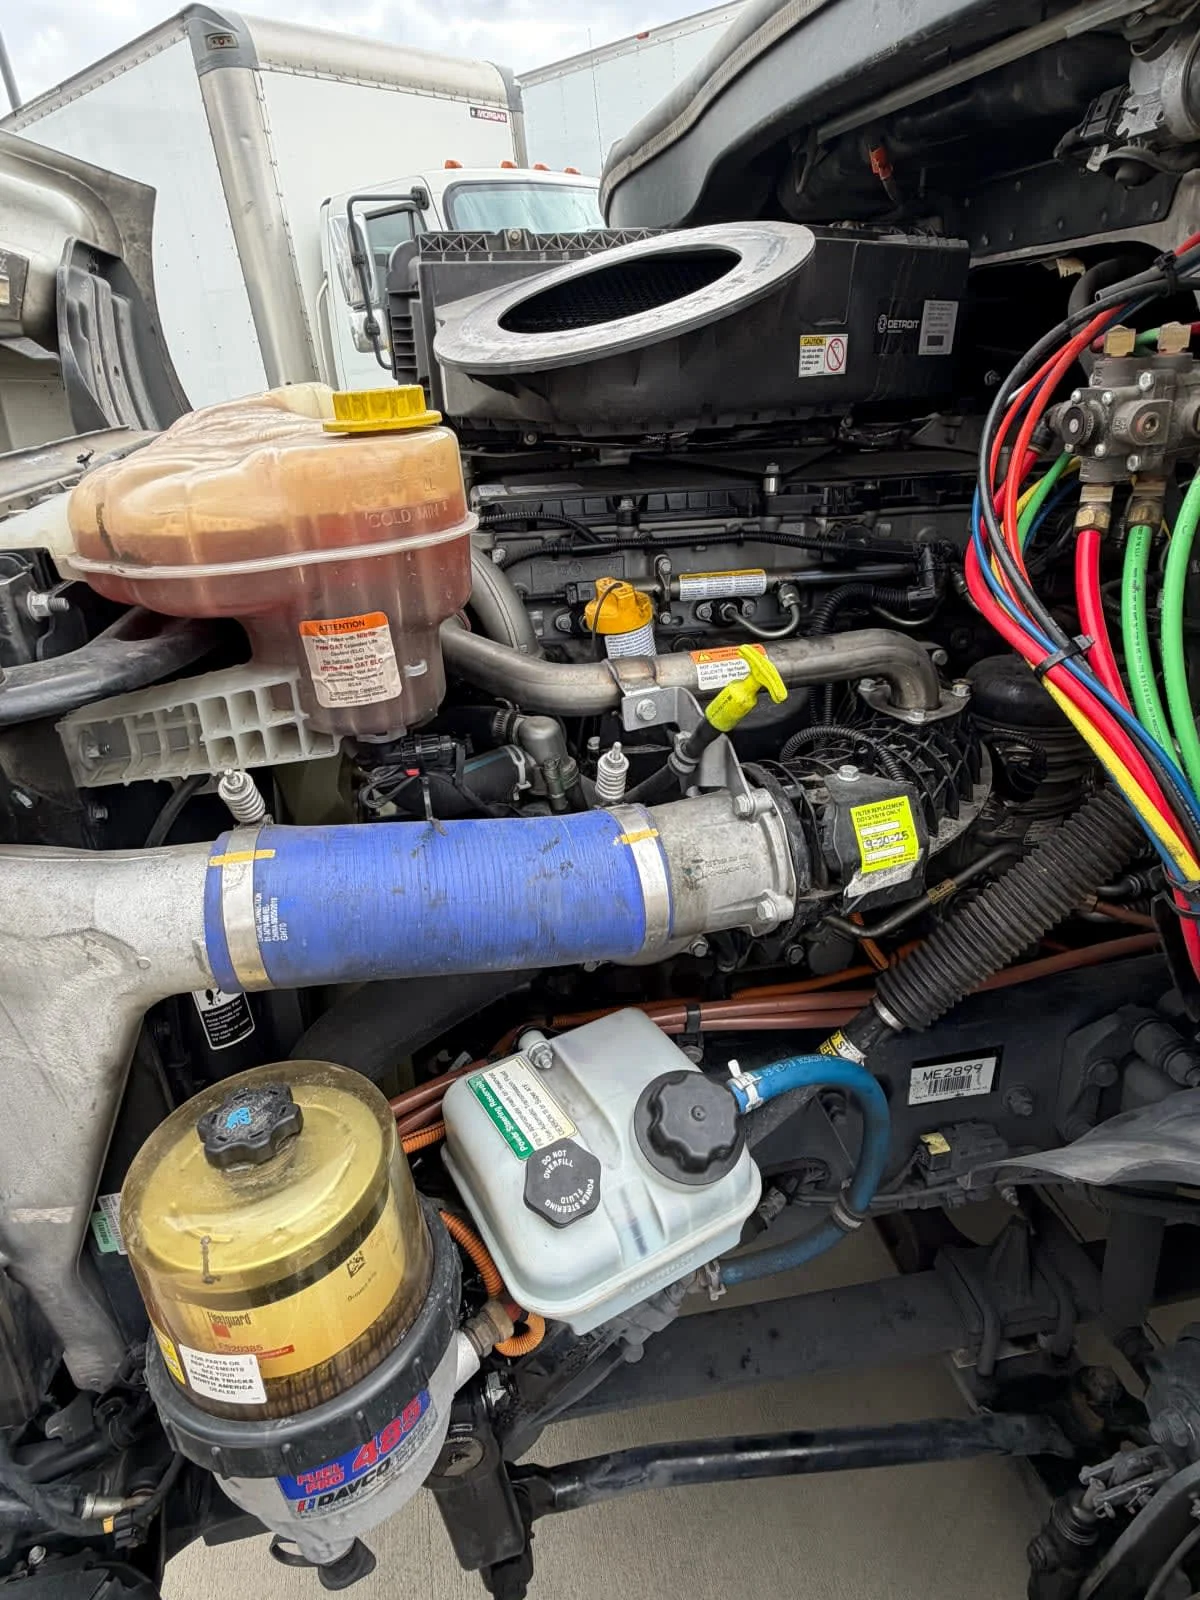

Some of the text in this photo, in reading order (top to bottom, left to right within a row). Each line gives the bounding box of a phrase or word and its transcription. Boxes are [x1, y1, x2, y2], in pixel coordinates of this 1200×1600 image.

[888, 319, 920, 329] DETROIT
[368, 508, 411, 528] COLD
[319, 620, 365, 632] ATTENTION
[855, 801, 904, 817] FILTER REPLACEMENT
[886, 809, 901, 817] ONLY
[499, 1069, 510, 1082] Fluid
[923, 1063, 983, 1081] ME2899
[492, 1104, 515, 1132] Steering
[509, 1129, 528, 1152] Power
[541, 1150, 567, 1166] DO NOT
[543, 1158, 574, 1179] OVERFILL
[544, 1178, 594, 1213] POWER STEERING
[560, 1188, 583, 1203] FLUID
[190, 1360, 245, 1372] REPLACEMENTS
[205, 1357, 227, 1366] PARTS
[209, 1387, 236, 1395] DEALER
[218, 1383, 254, 1391] AMERICA
[296, 1463, 344, 1486] FUEL
[352, 1395, 422, 1472] 485
[305, 1472, 345, 1494] PRO
[318, 1458, 391, 1507] DAVCO
